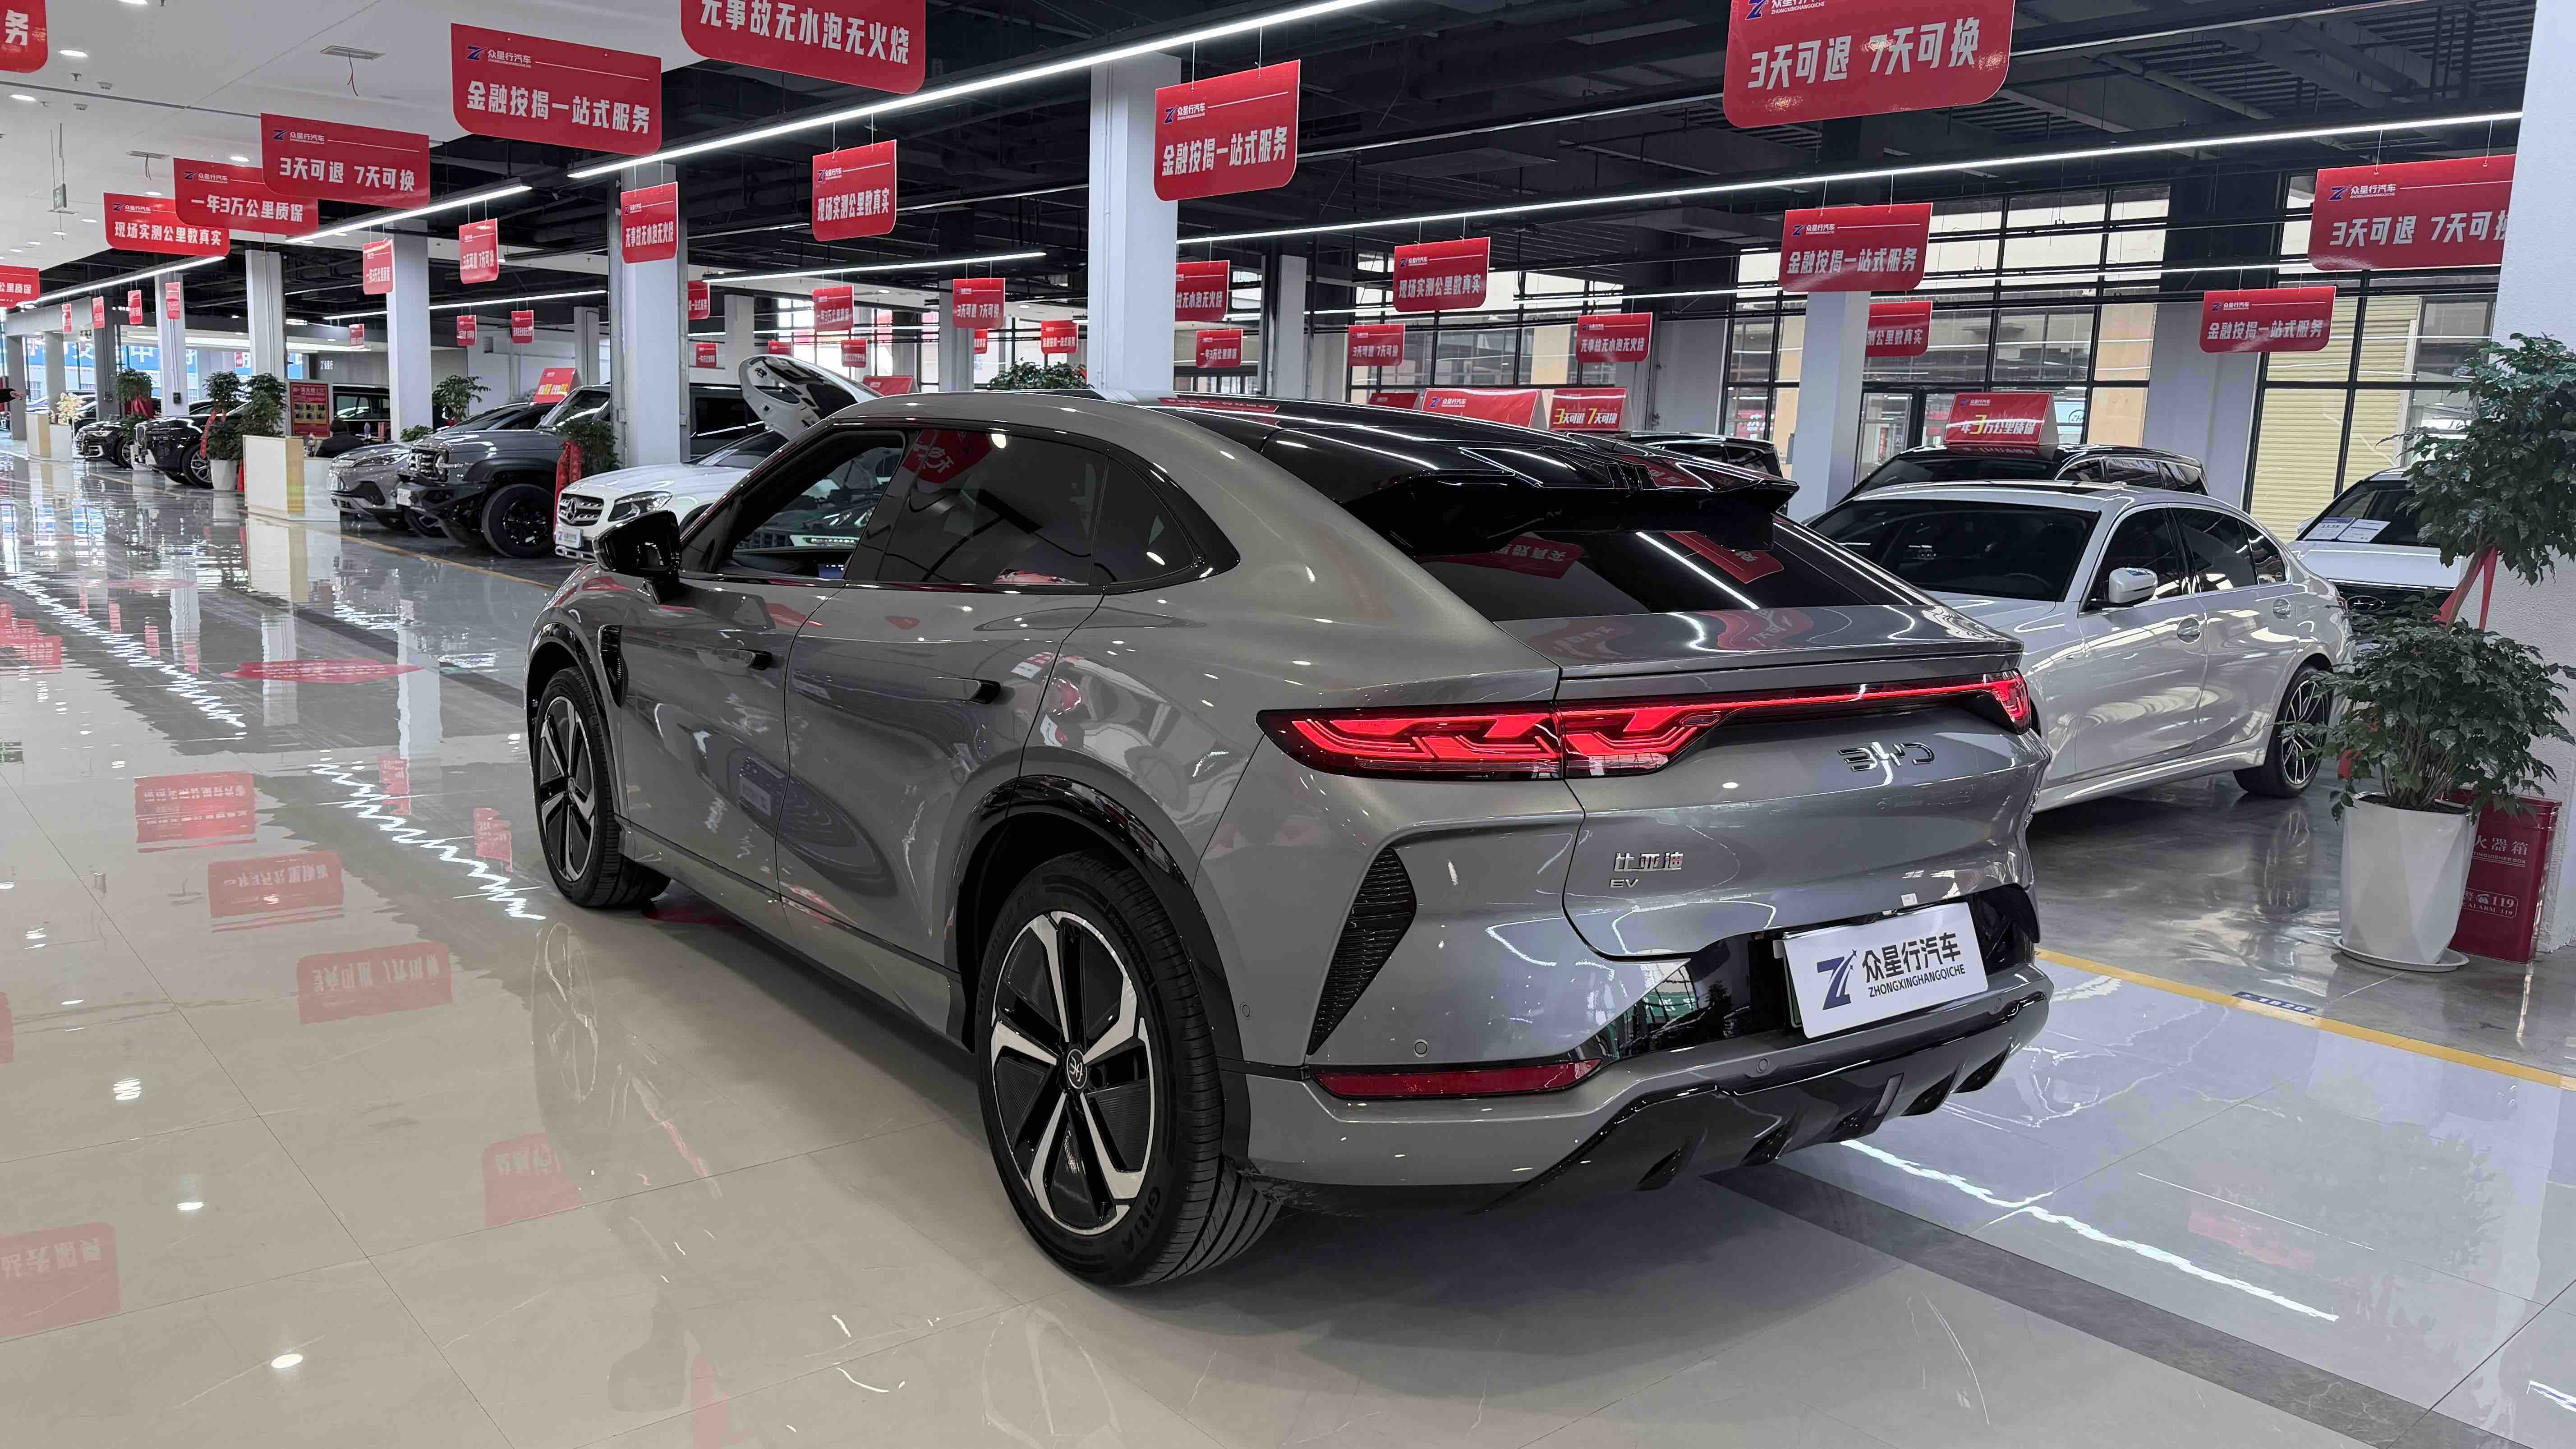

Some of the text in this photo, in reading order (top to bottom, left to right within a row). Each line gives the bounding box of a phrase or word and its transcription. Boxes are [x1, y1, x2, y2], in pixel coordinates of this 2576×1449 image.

[5, 9, 29, 46] 务
[699, 0, 909, 64] 无事故无水泡无火烧
[487, 49, 531, 64] 众星行汽车
[1748, 17, 1980, 90] 3天可退 7天可换
[467, 80, 649, 134] 金融按揭一站式服务
[1177, 102, 1205, 116] 众星行汽车
[1161, 126, 1288, 176] 金融按揭一站式服务
[279, 157, 414, 192] 3天可退 7天可换
[2351, 184, 2396, 195] 众星行汽车
[191, 194, 304, 222] 一年3万公里质保
[817, 187, 890, 221] 现场实测公里数真实
[115, 219, 221, 246] 现场实测公里数真实
[626, 223, 674, 248] 无事故无水泡无火烧
[2329, 216, 2414, 248] 3天可退
[1787, 247, 1918, 275] 金融按揭一站式服务
[1399, 273, 1482, 299] 现场实测公里数真实
[2208, 319, 2323, 341] 金融按揭一站式服务
[1581, 337, 1645, 354] 无事故无水泡无火烧
[1838, 741, 1935, 772] BYD
[1613, 851, 1684, 873] 比亚迪
[1610, 878, 1638, 888] EV
[2468, 902, 2496, 912] ALARM
[2493, 896, 2515, 908] 119
[1862, 931, 1963, 984] 众星行汽车
[1868, 963, 1966, 998] ZHONGXINGHANGQICHE
